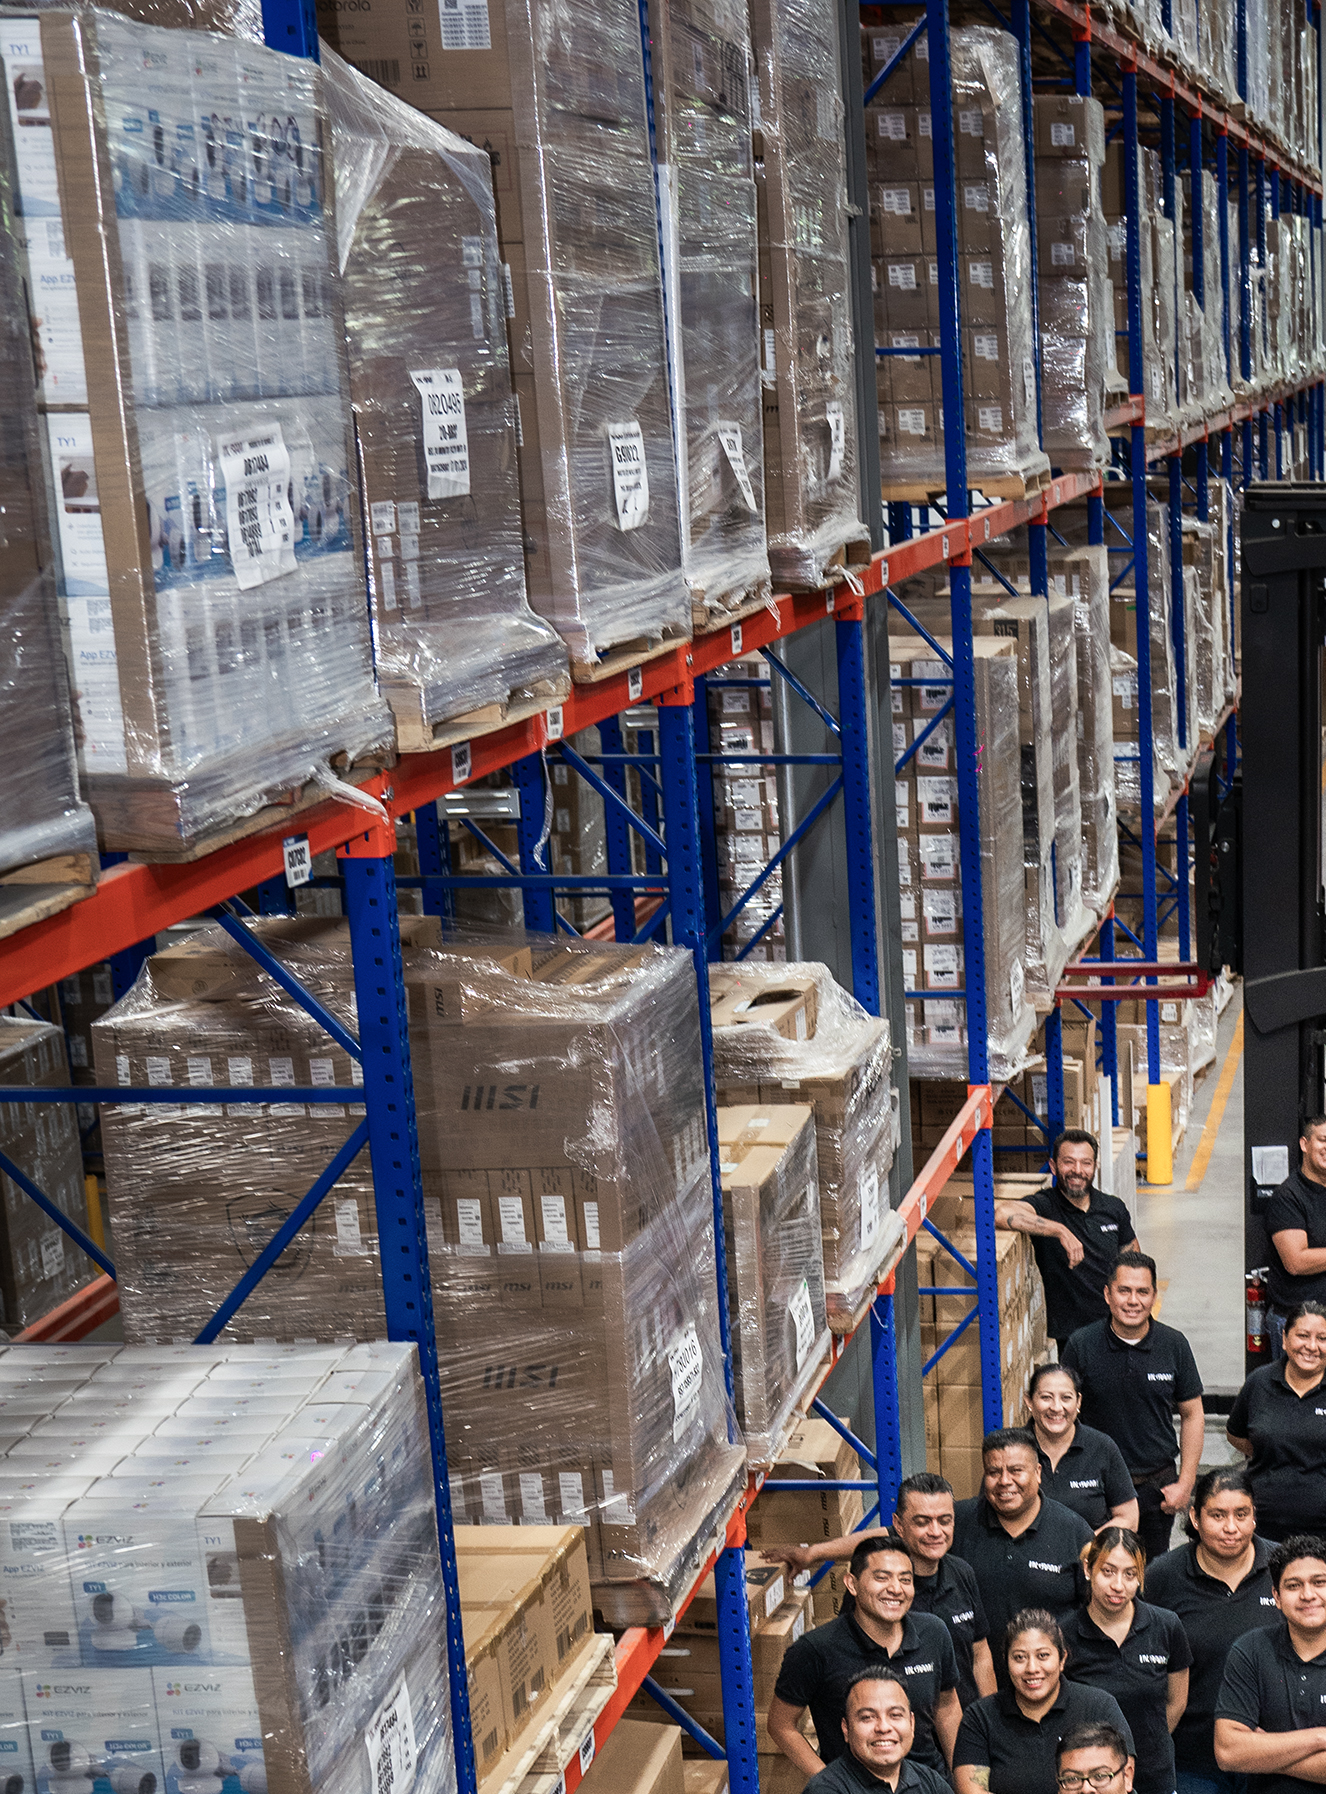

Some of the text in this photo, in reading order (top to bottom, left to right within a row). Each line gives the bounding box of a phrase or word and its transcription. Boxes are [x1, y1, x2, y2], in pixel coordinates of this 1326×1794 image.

[9, 43, 30, 56] TY1
[57, 436, 76, 448] TY1
[504, 1281, 532, 1292] msi
[545, 1281, 574, 1291] msi
[95, 1535, 134, 1545] EZVIZ
[204, 1537, 222, 1545] TY1
[53, 1686, 92, 1695] EZVIZ
[184, 1683, 222, 1692] EZVIZ
